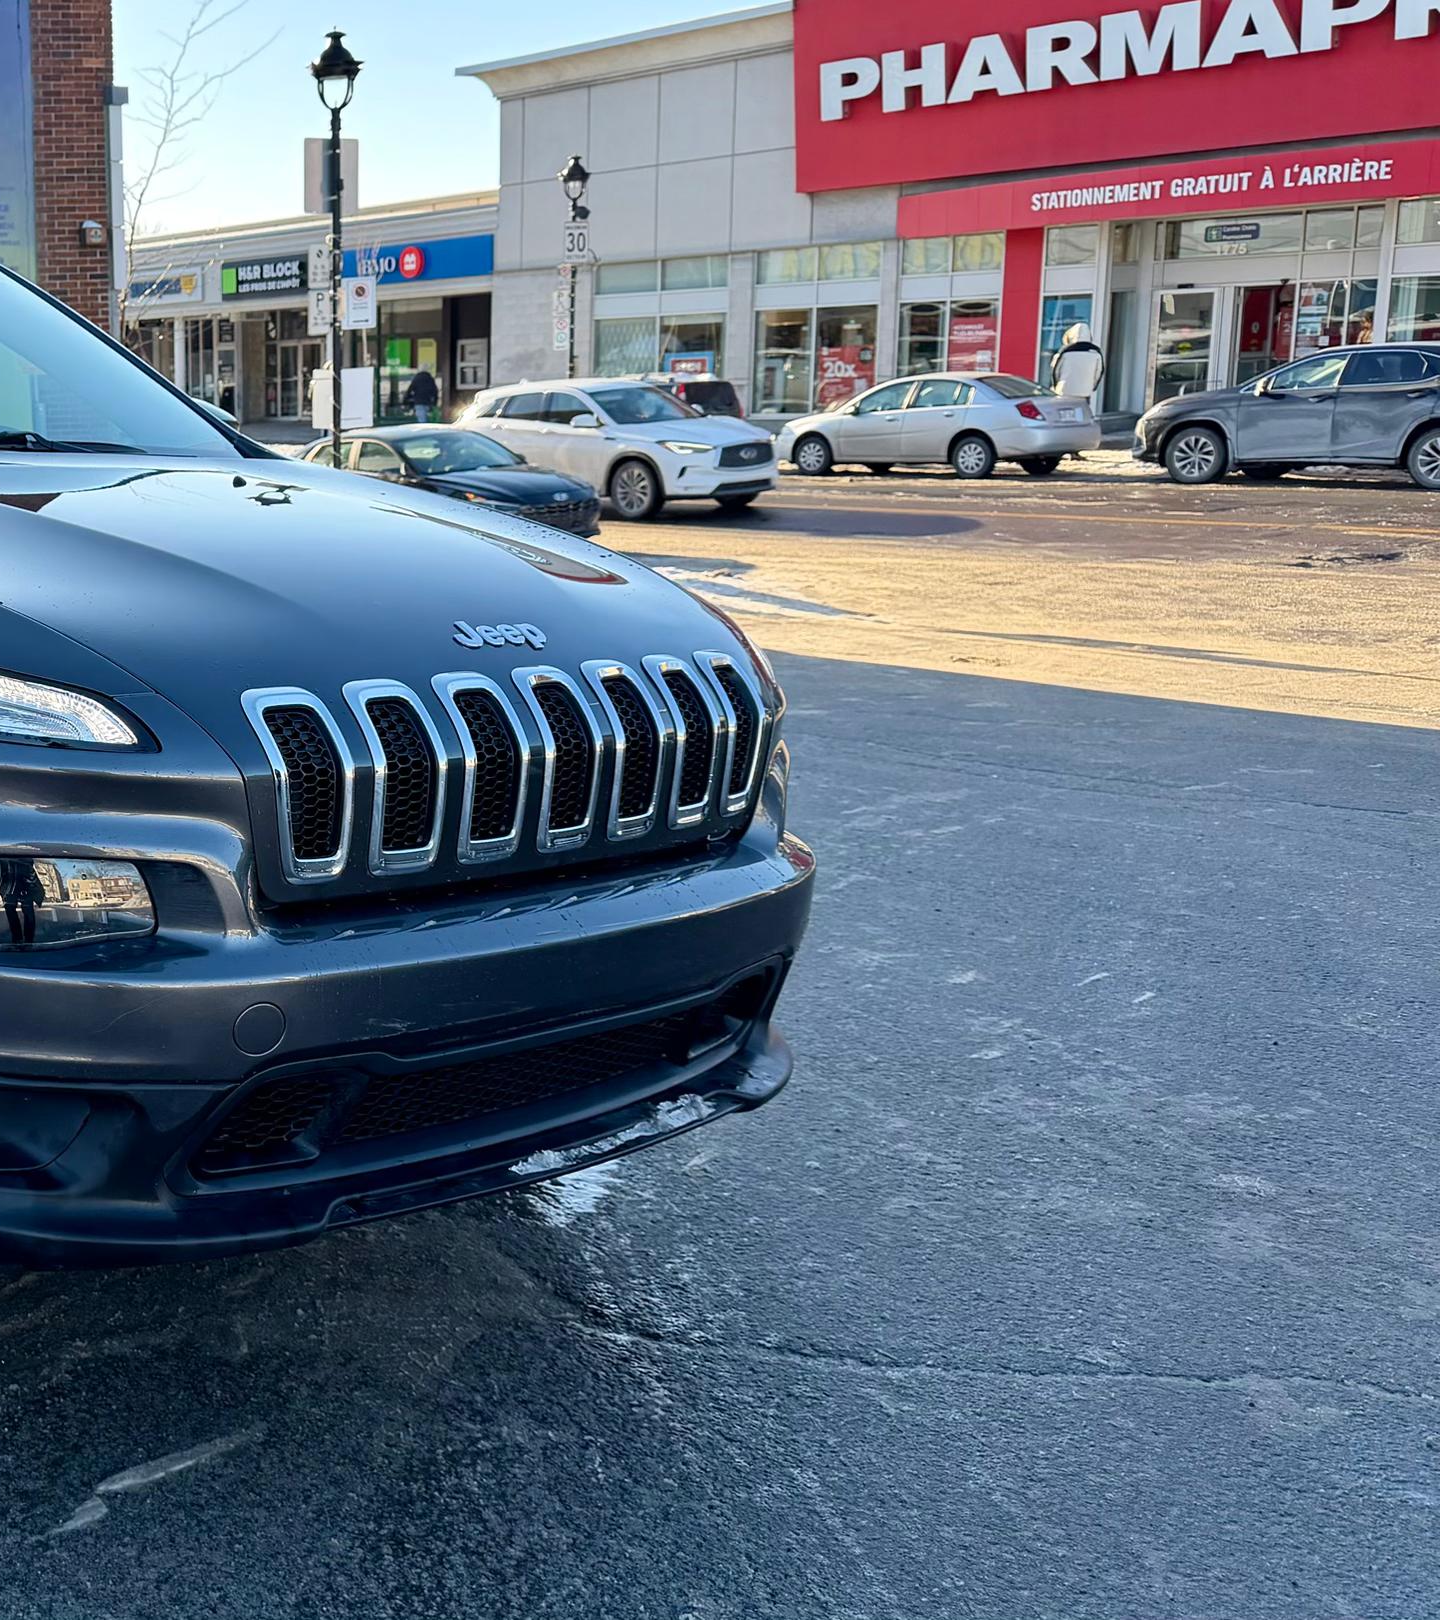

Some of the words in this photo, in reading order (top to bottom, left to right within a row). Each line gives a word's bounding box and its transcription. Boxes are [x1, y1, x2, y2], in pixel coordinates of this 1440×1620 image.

[1031, 180, 1164, 211] STATIONNEMENT
[1170, 172, 1253, 197] GRATUIT
[1260, 165, 1275, 190] À
[1282, 157, 1394, 188] L'ARRIÈRE
[566, 232, 586, 252] 30
[1217, 243, 1248, 255] 1775
[238, 264, 261, 281] H&R
[262, 259, 300, 278] BLOCK
[822, 360, 857, 378] 20x
[452, 620, 547, 649] Jeep
